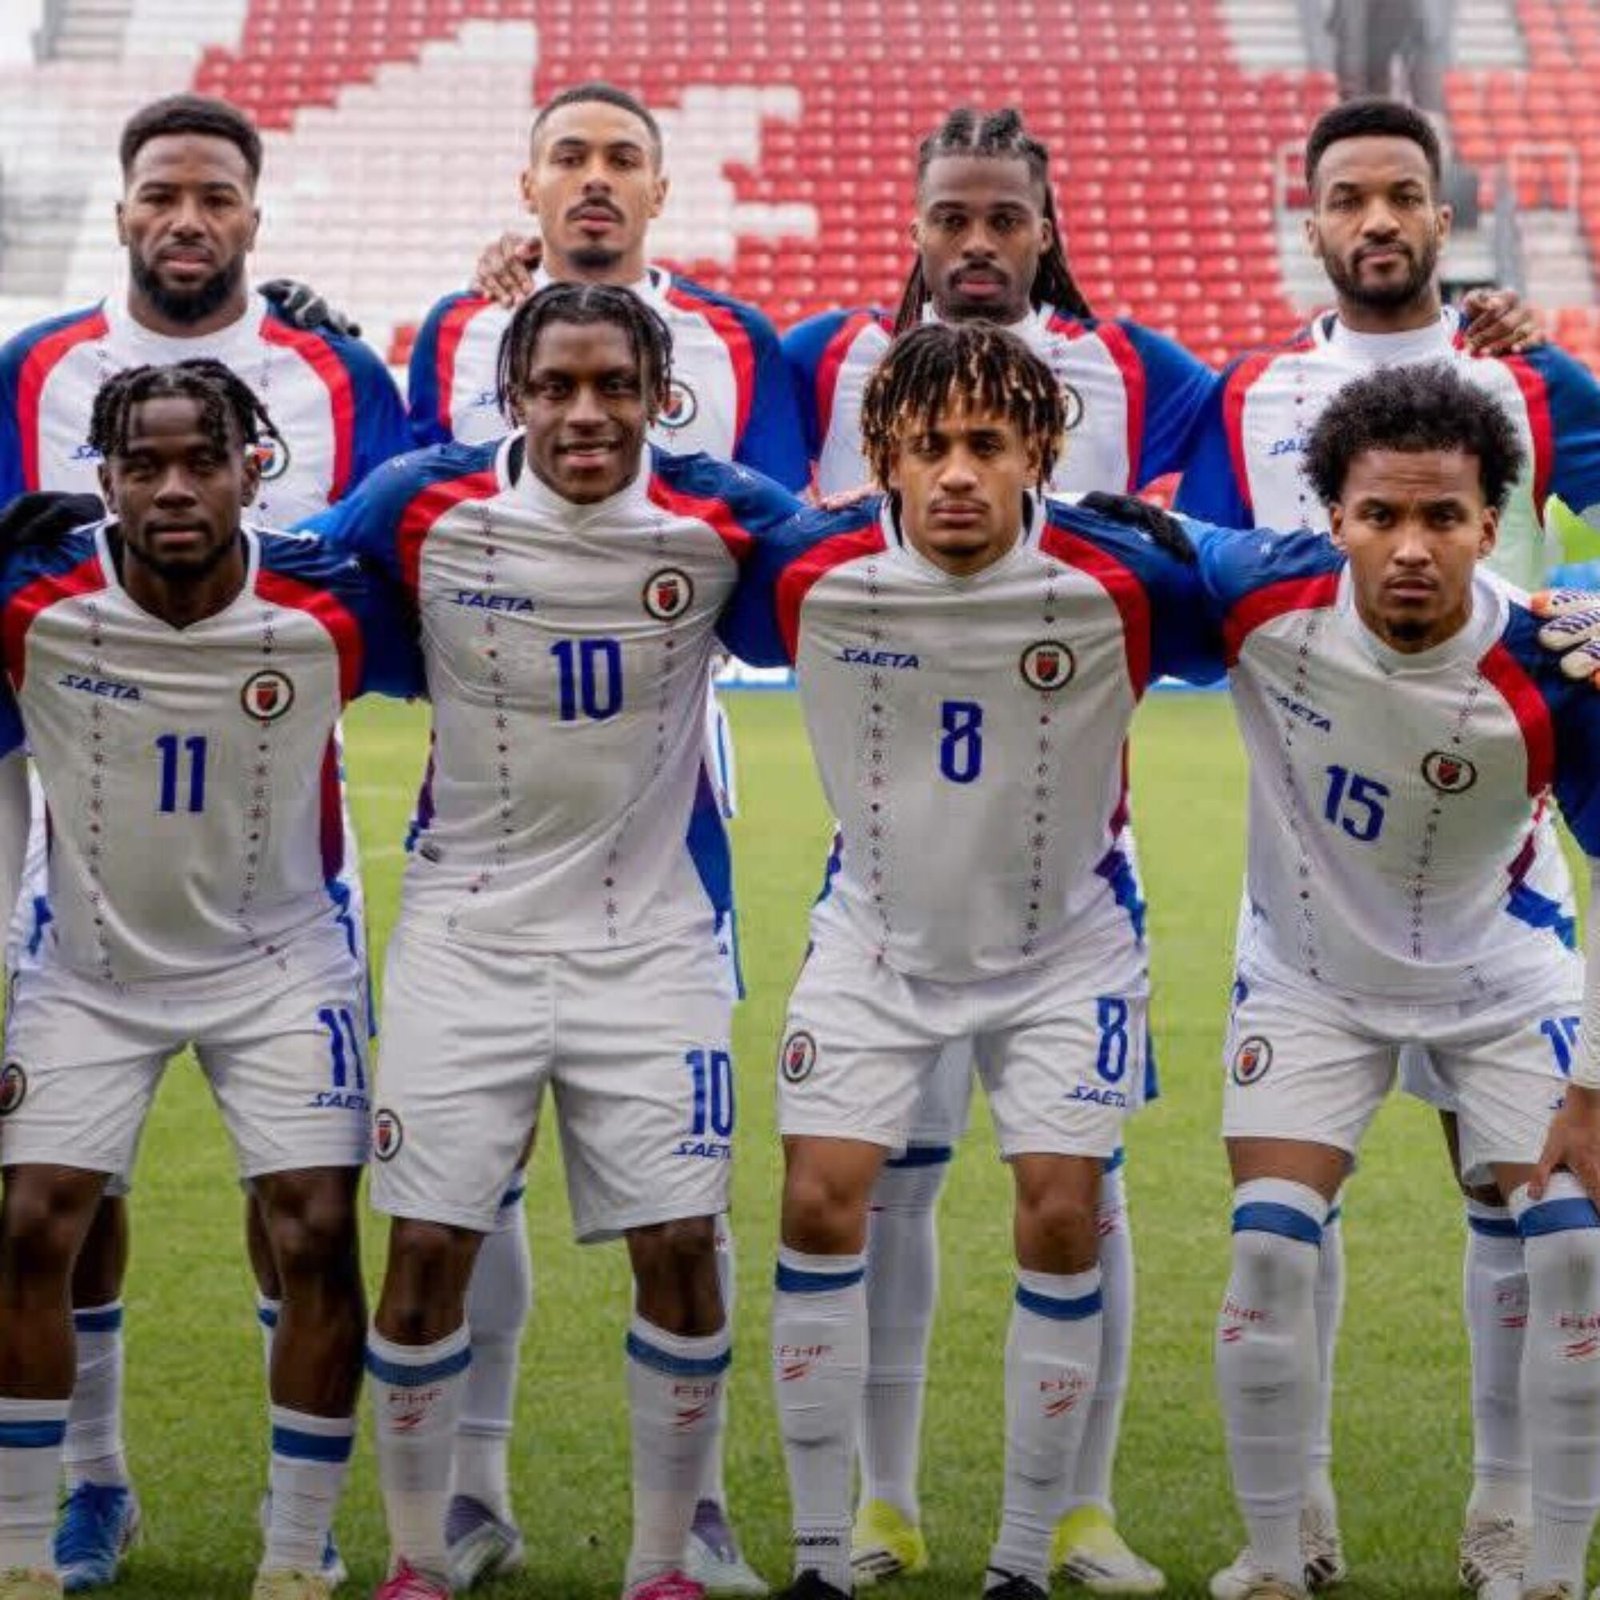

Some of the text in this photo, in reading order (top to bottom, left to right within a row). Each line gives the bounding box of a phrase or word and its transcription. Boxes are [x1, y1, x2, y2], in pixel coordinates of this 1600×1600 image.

[449, 590, 535, 612] SAETA
[58, 673, 142, 701] SAETA
[550, 638, 623, 721] 10
[836, 648, 920, 669] SAETA
[156, 733, 208, 813] 11
[940, 700, 983, 782] 8
[1324, 764, 1390, 842] 15
[317, 1007, 365, 1090] 11
[1096, 995, 1128, 1084] 8
[685, 1049, 734, 1137] 10
